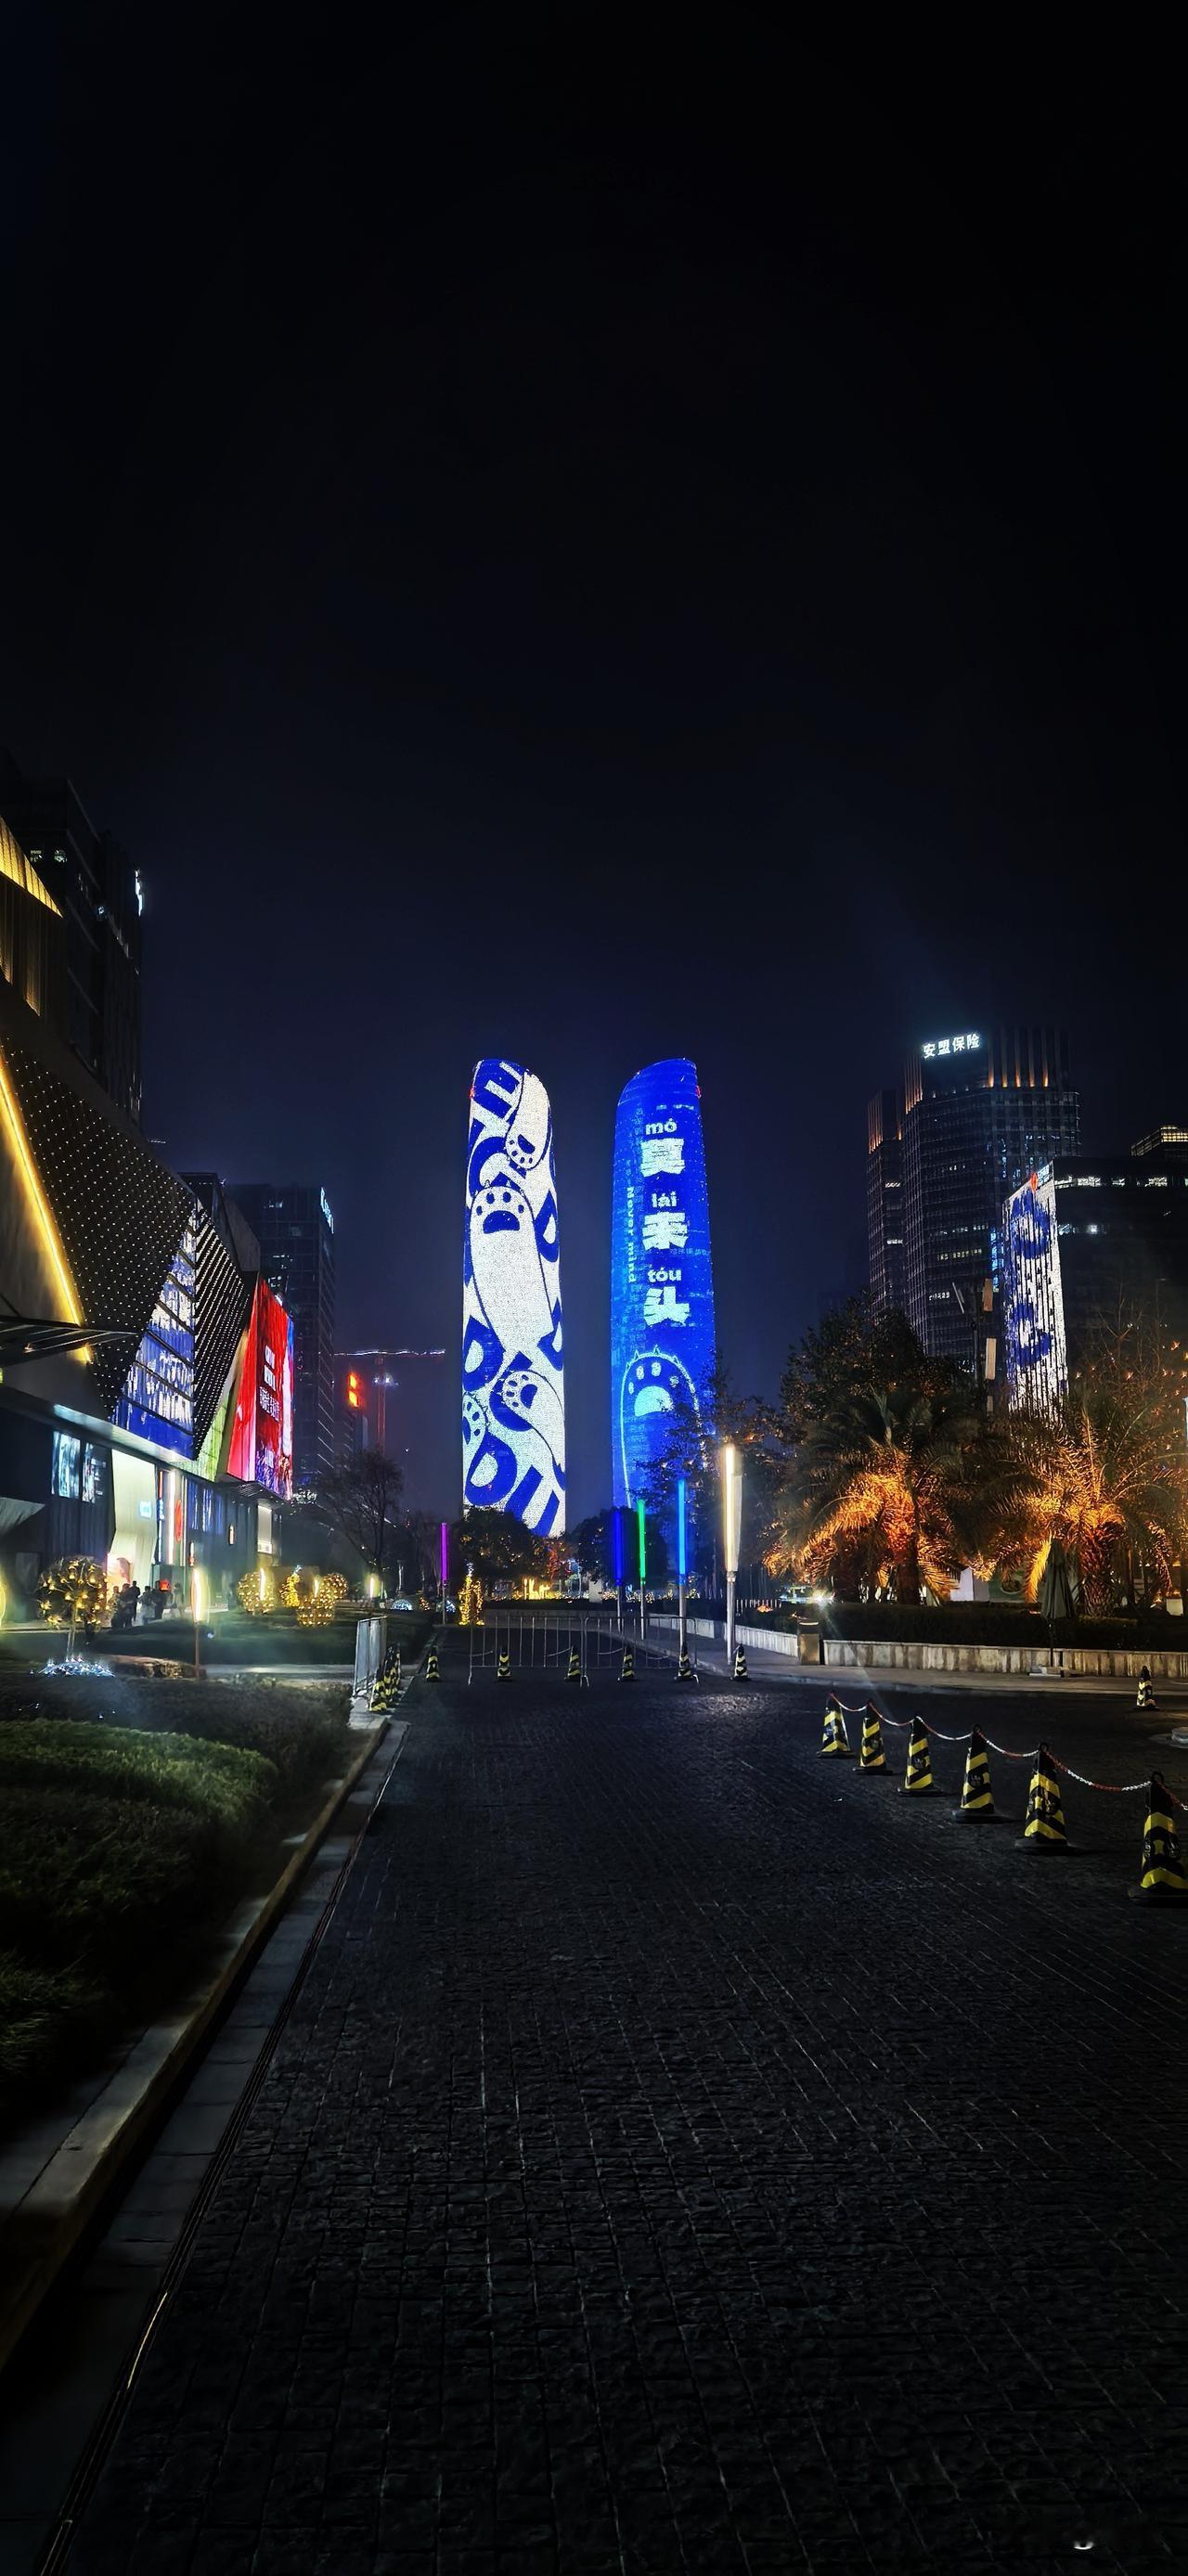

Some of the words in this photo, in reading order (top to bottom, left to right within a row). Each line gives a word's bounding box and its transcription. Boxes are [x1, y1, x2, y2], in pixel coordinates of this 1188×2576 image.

[923, 1033, 980, 1059] 安盟保险
[652, 1191, 678, 1208] lái
[648, 1267, 682, 1282] tóu
[643, 1286, 691, 1326] 头
